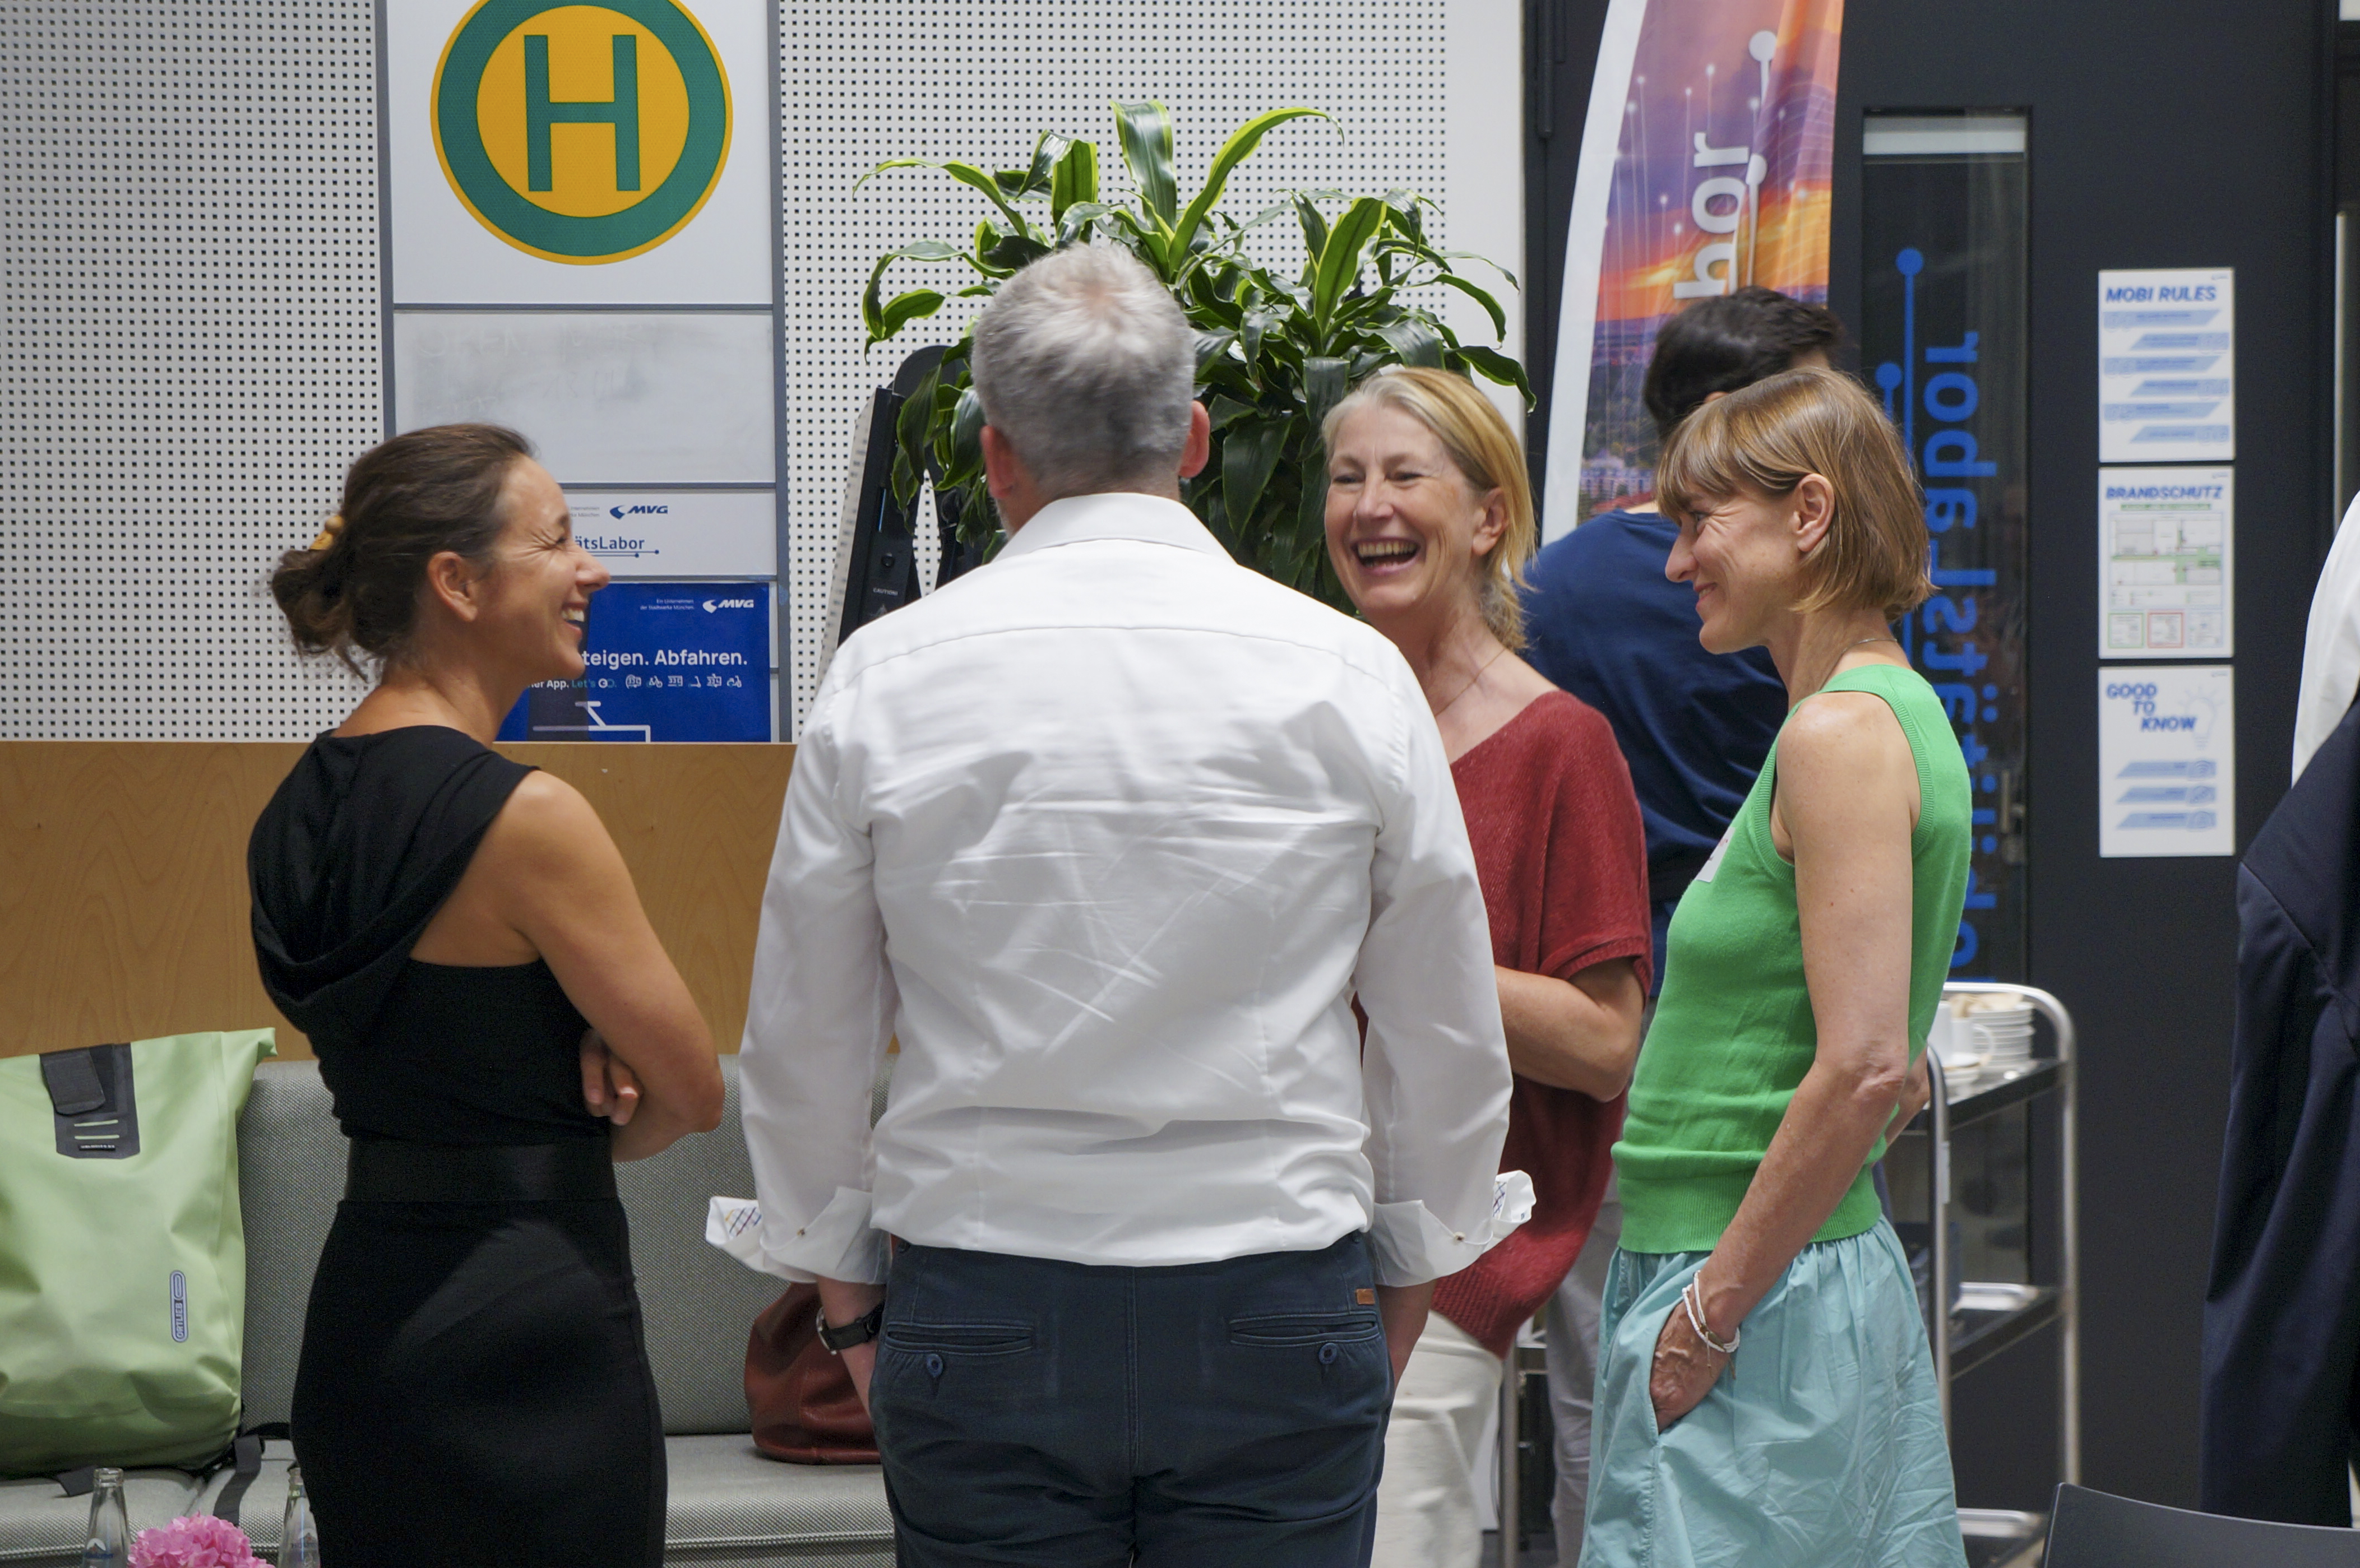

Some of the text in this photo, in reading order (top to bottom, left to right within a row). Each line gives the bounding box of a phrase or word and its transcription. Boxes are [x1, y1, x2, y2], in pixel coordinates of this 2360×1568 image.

[524, 34, 640, 192] H
[2106, 286, 2216, 303] MOBI RULES
[2106, 486, 2223, 499] BRANDSCHUTZ
[627, 505, 668, 514] MVG
[718, 599, 754, 608] MVG
[654, 650, 748, 666] Abfahren.
[547, 680, 570, 690] App.
[2107, 683, 2157, 699] GOOD
[2132, 701, 2156, 716] TO
[2140, 716, 2197, 732] KNOW
